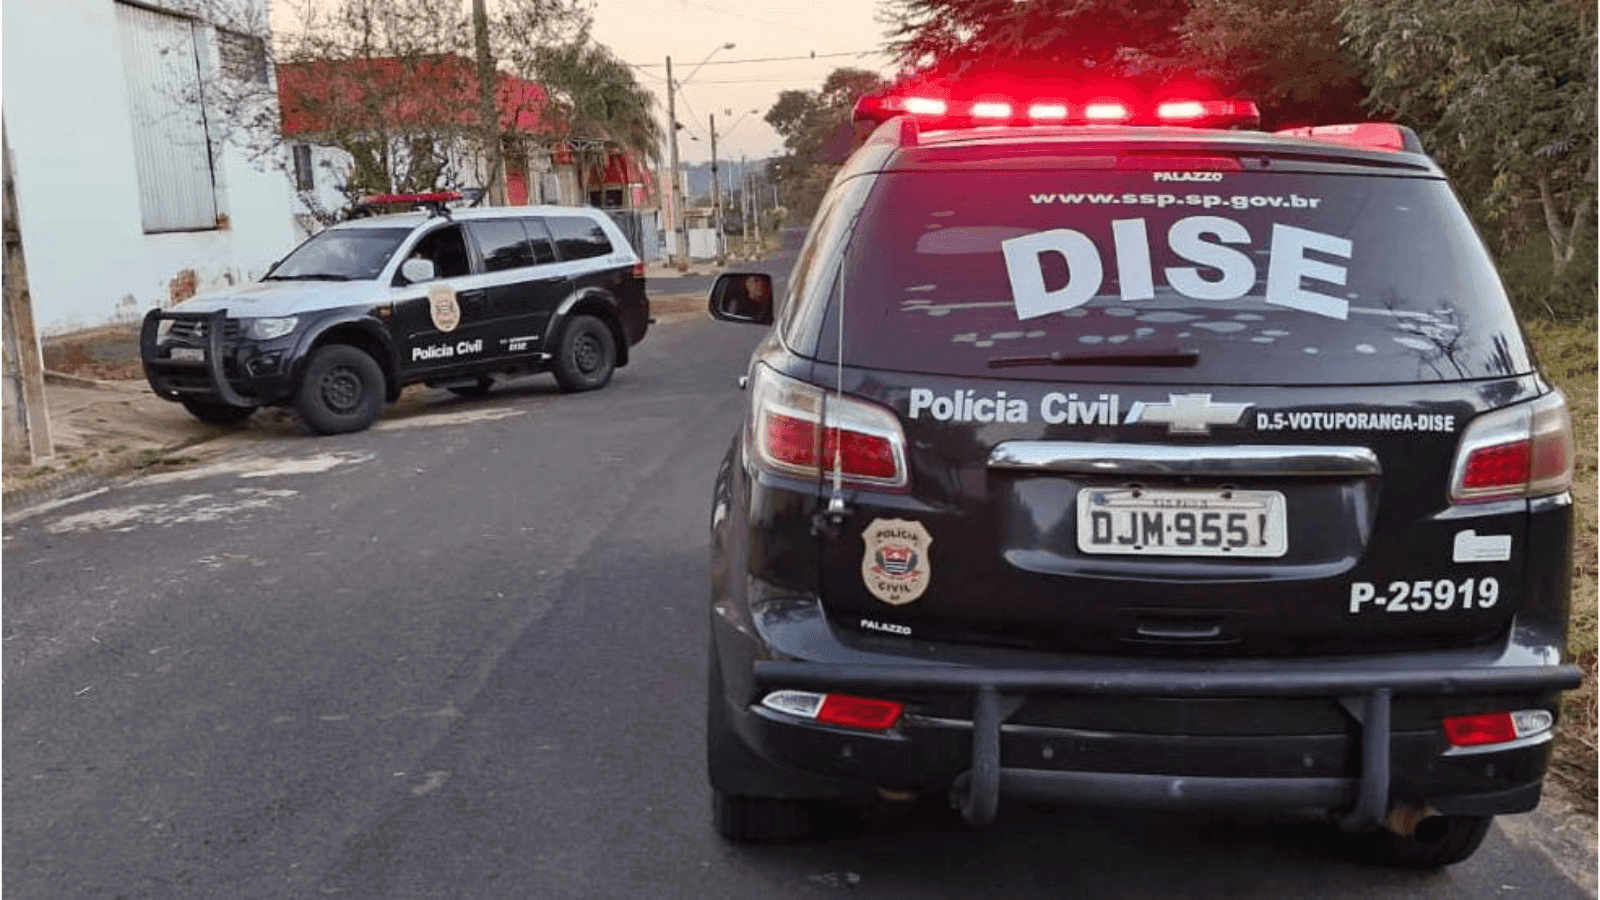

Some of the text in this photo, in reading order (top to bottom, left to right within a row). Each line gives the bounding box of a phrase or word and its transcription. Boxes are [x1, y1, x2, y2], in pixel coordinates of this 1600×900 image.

[1152, 171, 1223, 182] PALAZZO
[1029, 193, 1322, 209] www.ssp.sp.gov.br
[1001, 215, 1353, 321] DISE
[456, 338, 483, 355] Civil
[909, 387, 1120, 426] Polícia Civil
[1256, 411, 1456, 432] D.5-VOTUPORANGA-DISE
[878, 582, 911, 593] CIVIL
[1349, 576, 1500, 614] P-25919
[860, 619, 912, 635] PALAZZO
